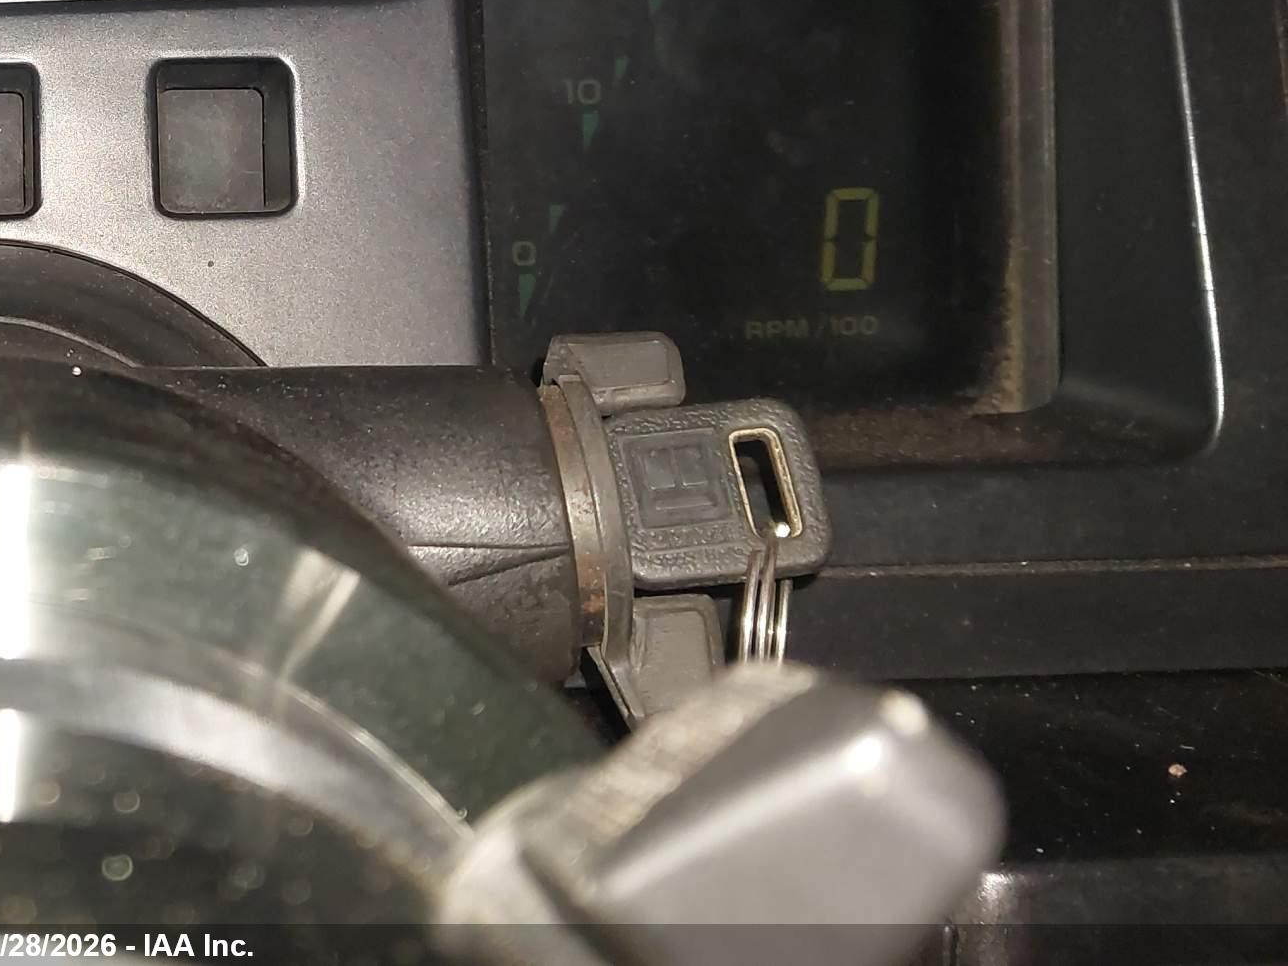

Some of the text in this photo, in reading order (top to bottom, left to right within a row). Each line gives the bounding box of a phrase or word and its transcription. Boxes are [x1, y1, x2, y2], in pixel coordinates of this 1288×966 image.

[564, 79, 602, 105] 10
[819, 187, 880, 292] 0
[512, 240, 538, 266] 0
